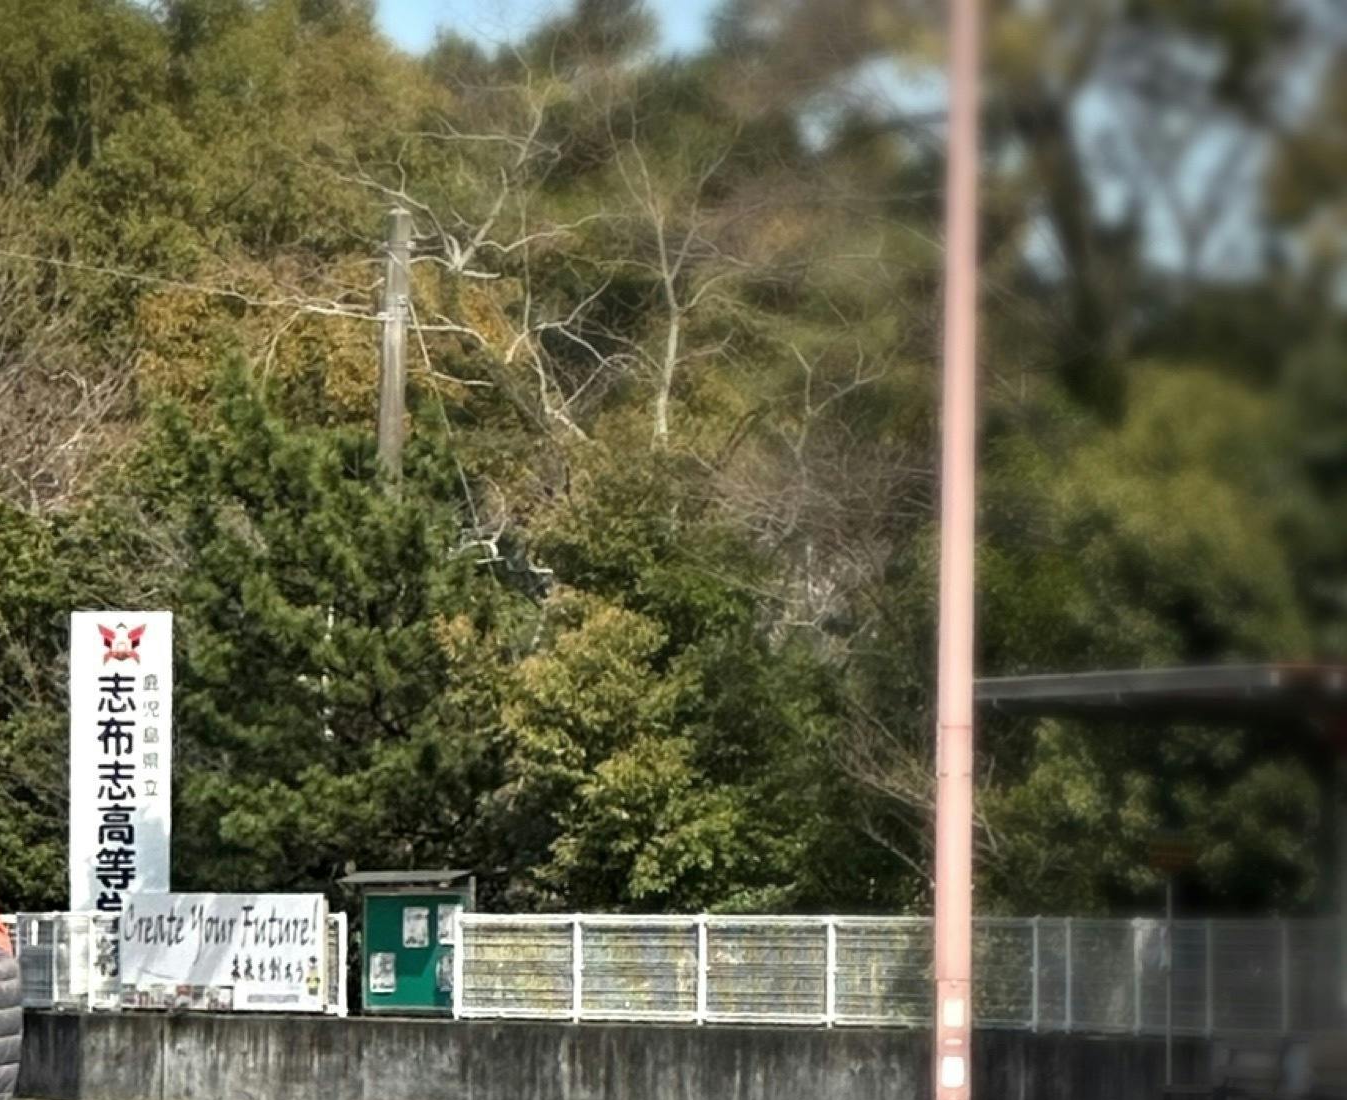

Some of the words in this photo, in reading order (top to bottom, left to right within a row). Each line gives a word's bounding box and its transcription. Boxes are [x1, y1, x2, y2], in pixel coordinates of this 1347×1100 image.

[142, 673, 160, 797] 鹿児島県立
[124, 903, 185, 947] Create
[191, 903, 238, 960] Your
[241, 898, 319, 948] Future!
